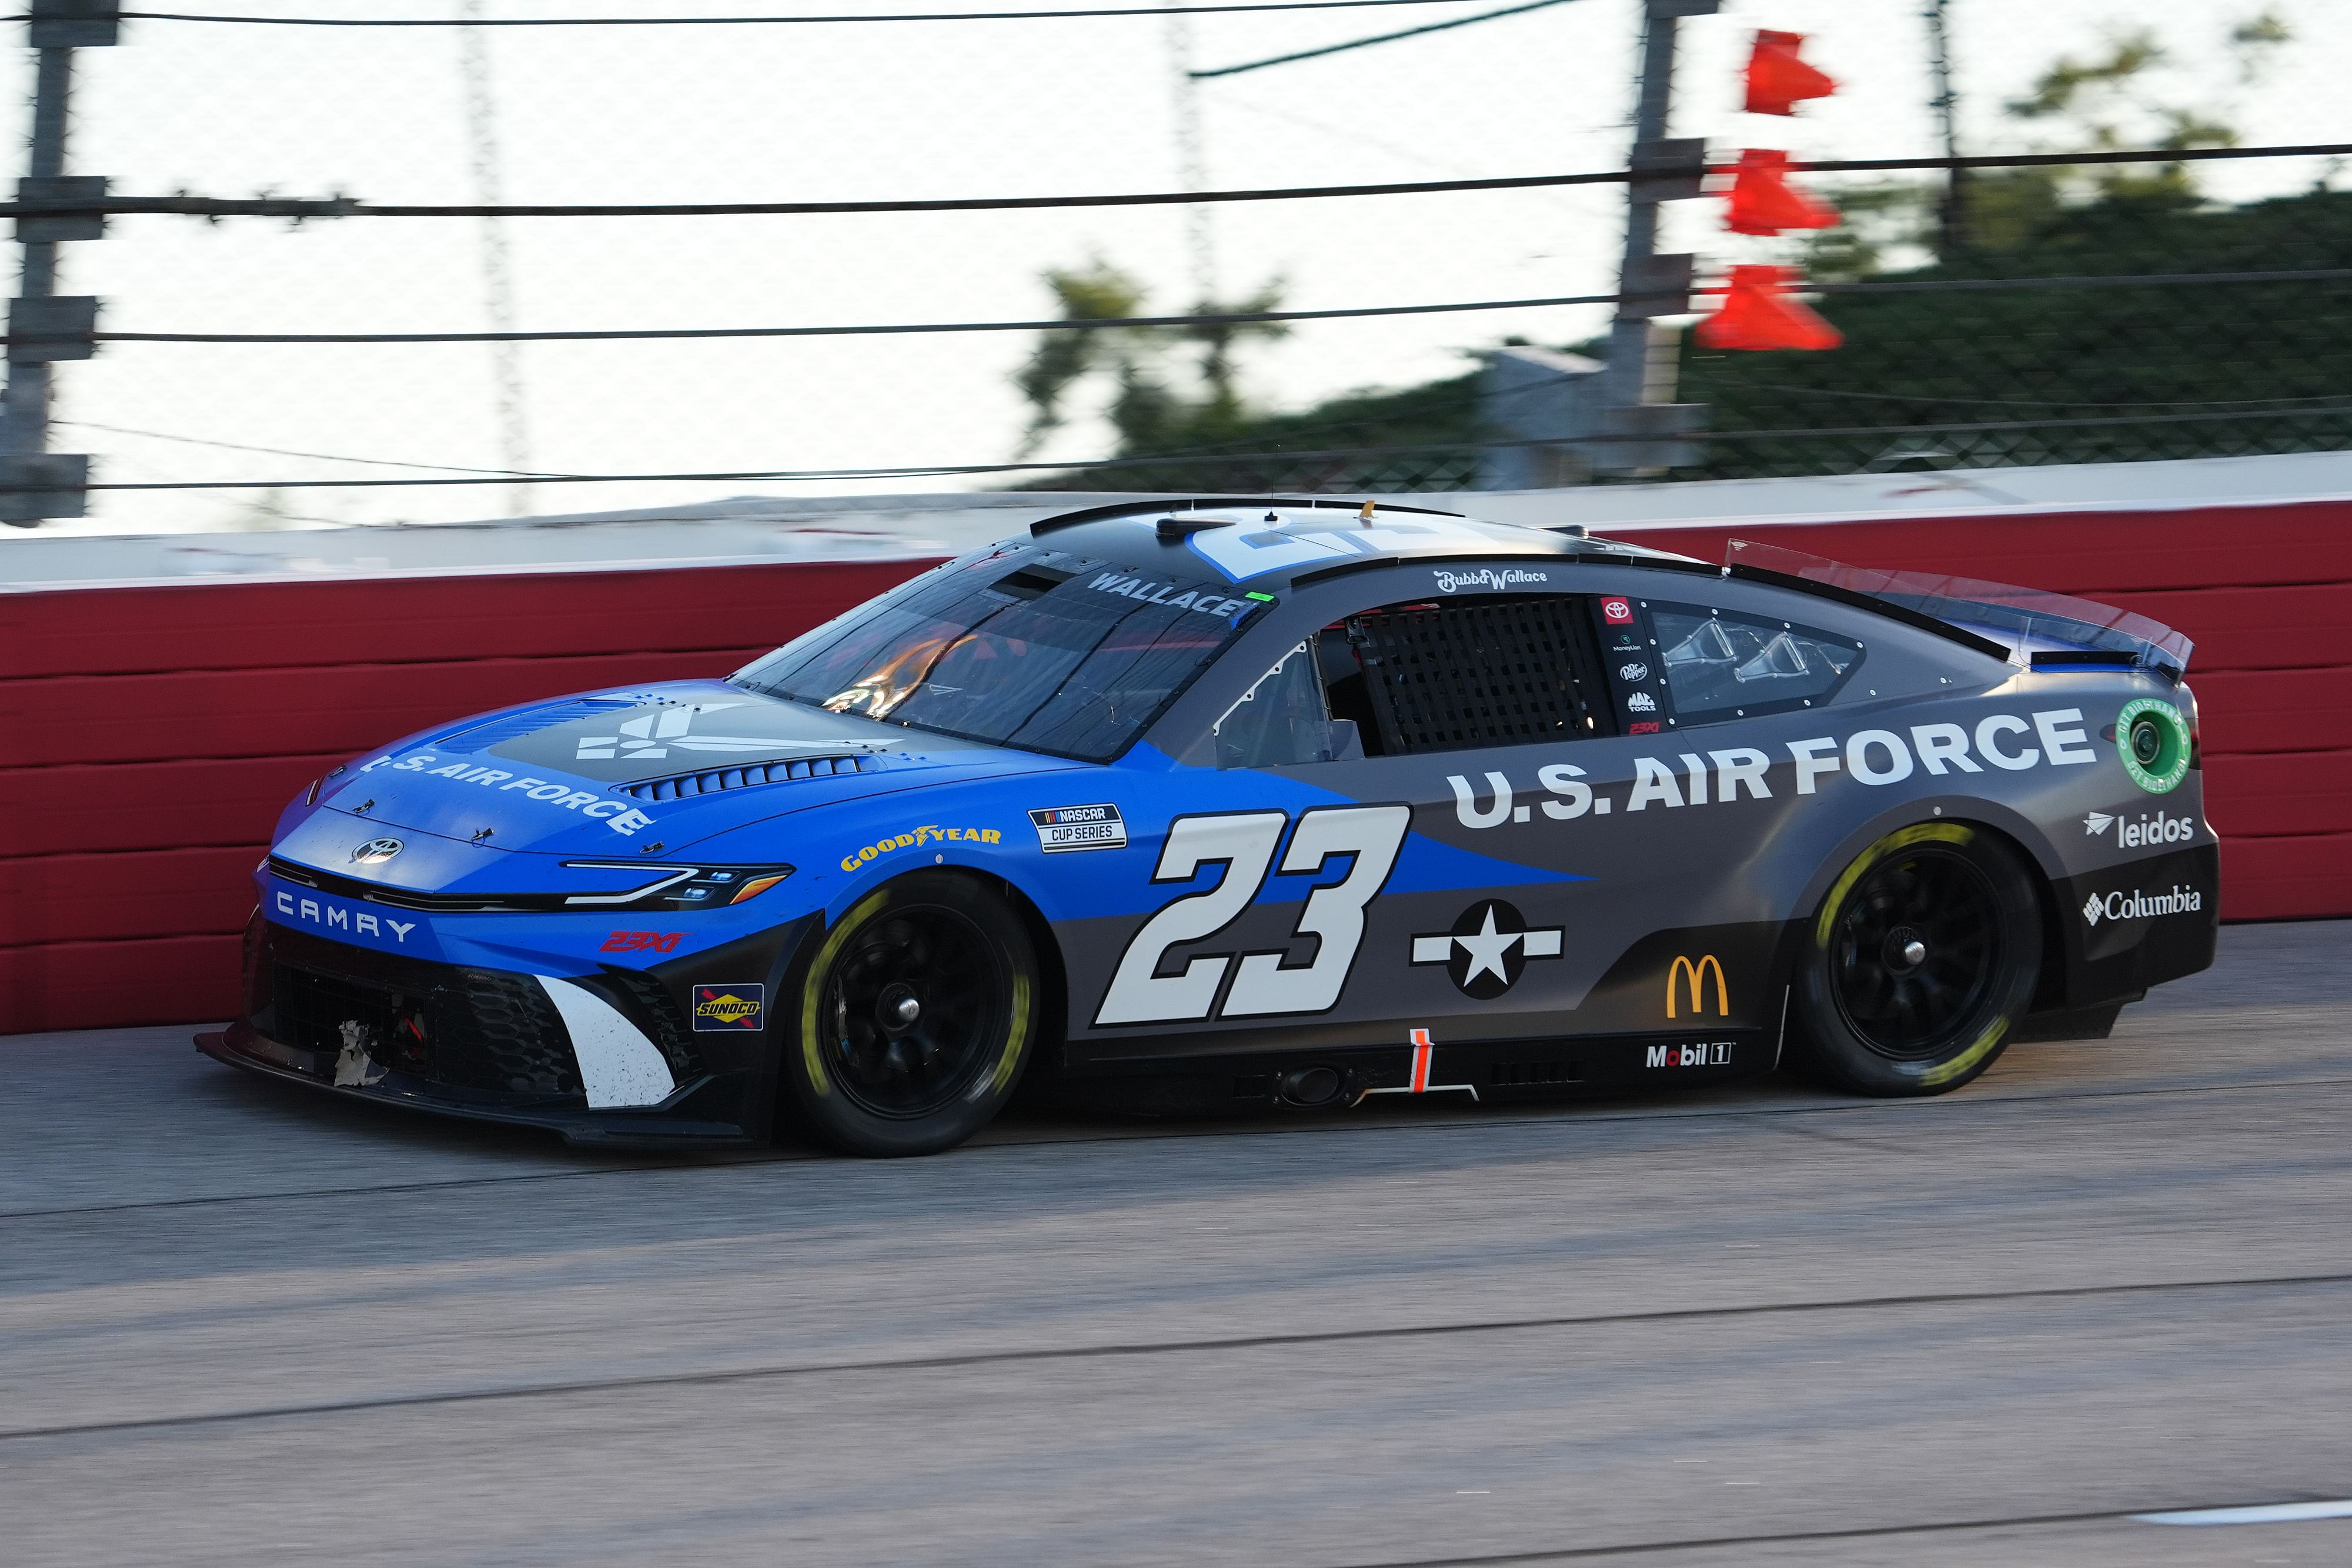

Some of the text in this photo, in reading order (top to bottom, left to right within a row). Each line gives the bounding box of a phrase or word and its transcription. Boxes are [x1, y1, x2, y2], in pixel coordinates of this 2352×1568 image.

[1087, 572, 1245, 617] WALLACE
[1620, 666, 1645, 680] Pepper
[1628, 691, 1656, 706] MAC
[1446, 708, 2097, 828] U.S. AIR FORCE
[425, 763, 513, 787] AIR
[498, 777, 657, 837] FORCE
[1059, 808, 1106, 823] NASCAR
[1051, 825, 1112, 841] CUP SERIES
[2118, 811, 2194, 848] leidos
[277, 891, 416, 942] CAMRY
[1089, 802, 1414, 1029] 23
[2104, 884, 2202, 920] Columbia
[698, 1002, 759, 1015] SUNOCO
[1646, 1043, 1708, 1068] Mobil
